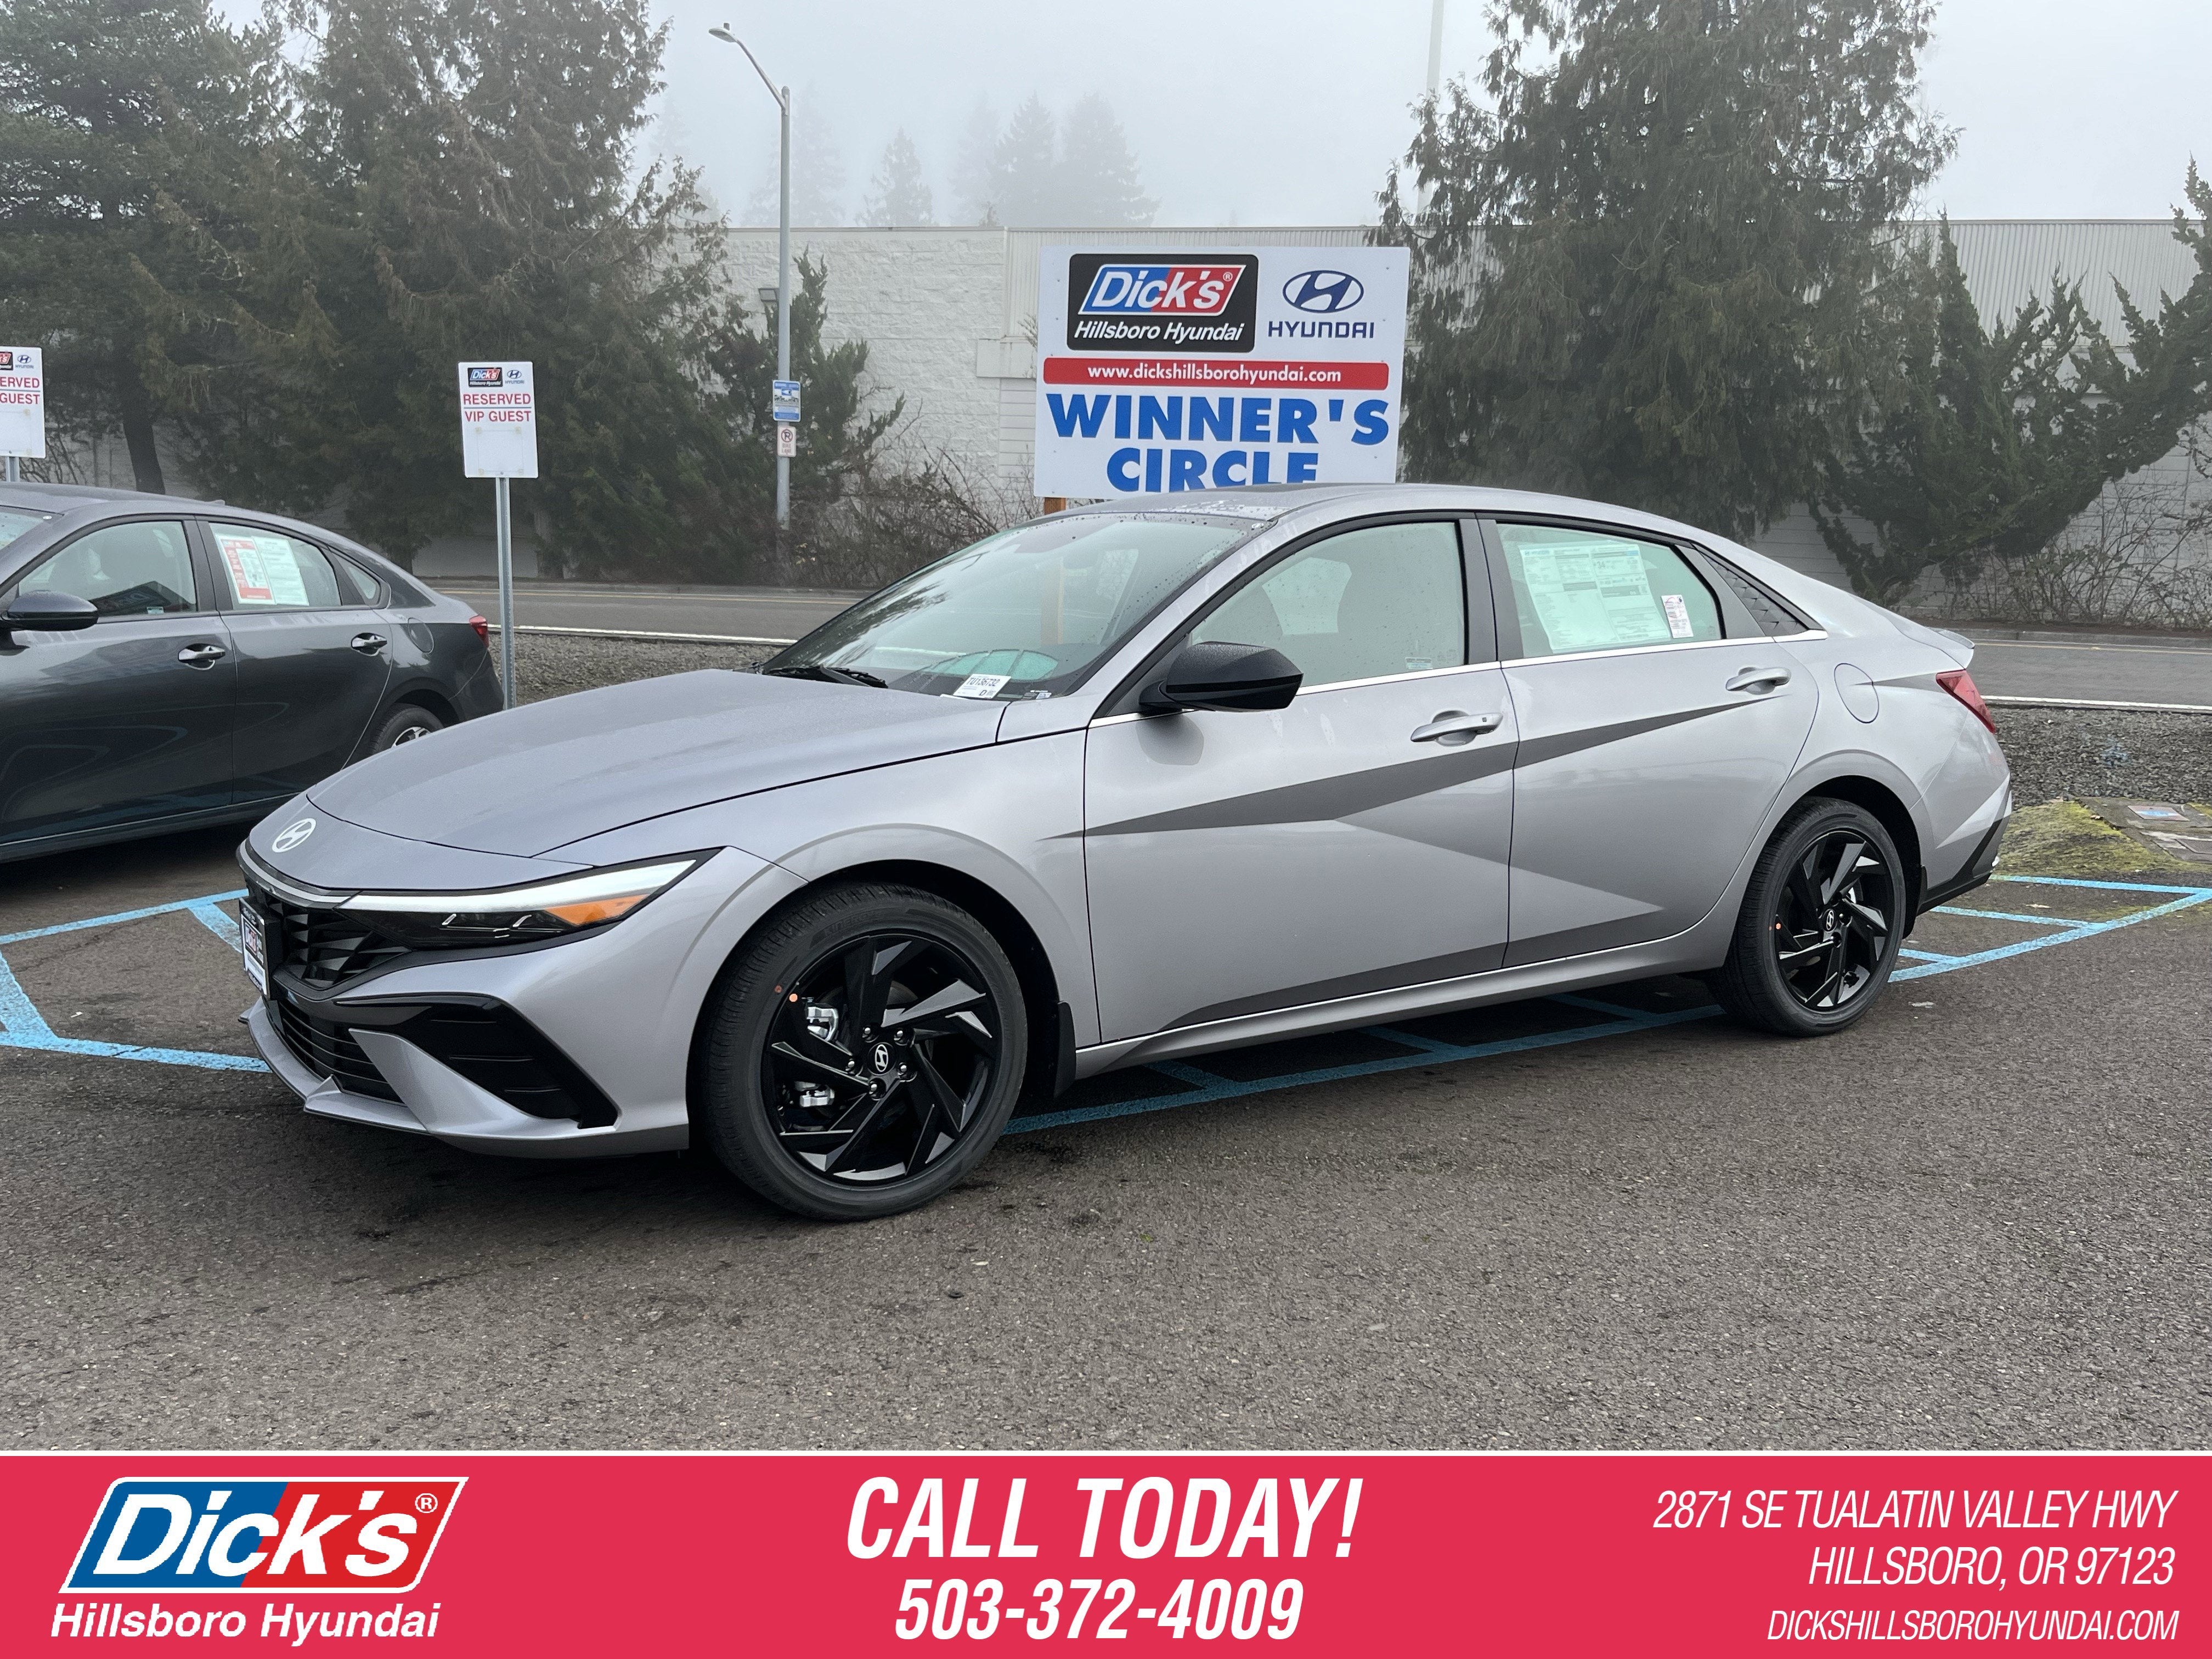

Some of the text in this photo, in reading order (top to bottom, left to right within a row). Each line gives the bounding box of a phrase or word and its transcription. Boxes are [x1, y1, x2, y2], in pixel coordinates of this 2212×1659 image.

[1092, 270, 1224, 309] Dick's
[1074, 321, 1245, 345] Hillsboro Hyundai
[1268, 321, 1374, 338] HYUNDAI
[0, 376, 40, 388] ERVED
[1087, 364, 1341, 385] www.dickshillsborohyundai.com
[0, 393, 40, 405] GUEST
[462, 393, 531, 405] RESERVED
[465, 411, 532, 422] VIP GUEST
[1046, 393, 1389, 445] WINNER'S
